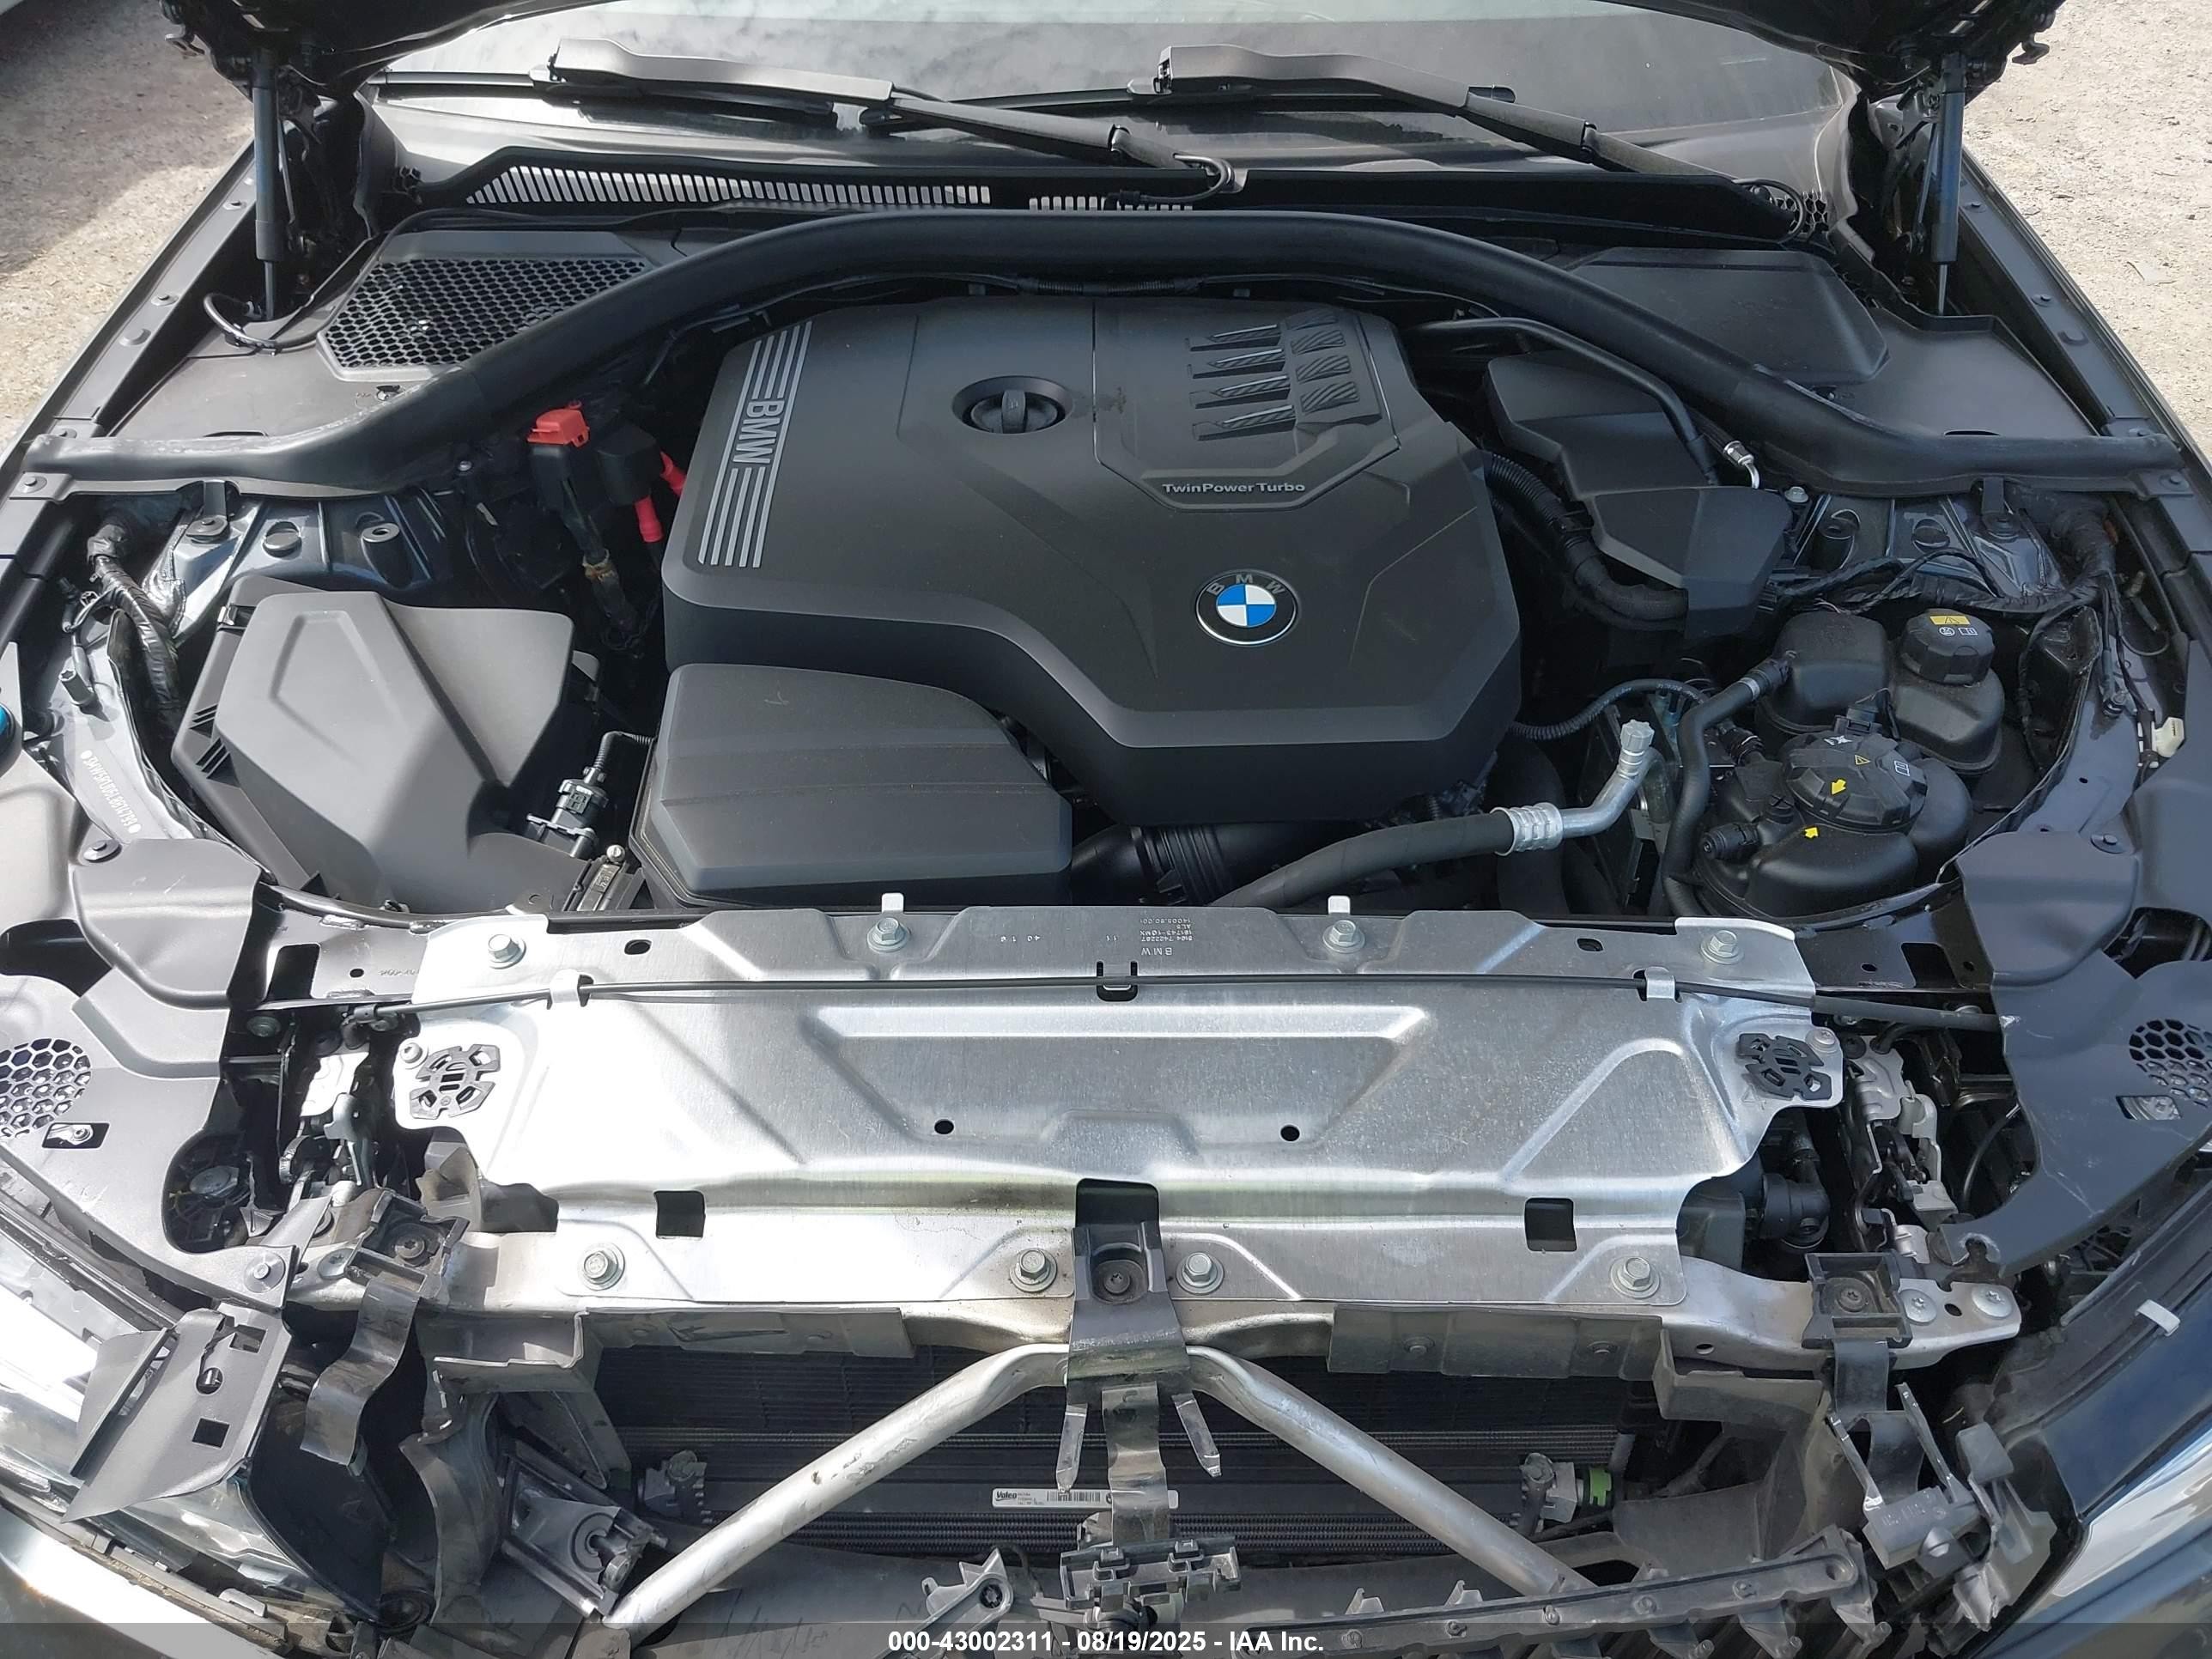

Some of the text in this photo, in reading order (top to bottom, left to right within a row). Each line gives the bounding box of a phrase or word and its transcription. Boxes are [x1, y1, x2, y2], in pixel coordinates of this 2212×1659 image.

[732, 400, 785, 464] BMW
[1162, 483, 1306, 493] TwinPower Turbo
[1206, 574, 1285, 596] BMW
[1141, 947, 1173, 956] BMW
[996, 1491, 1018, 1499] Valeo
